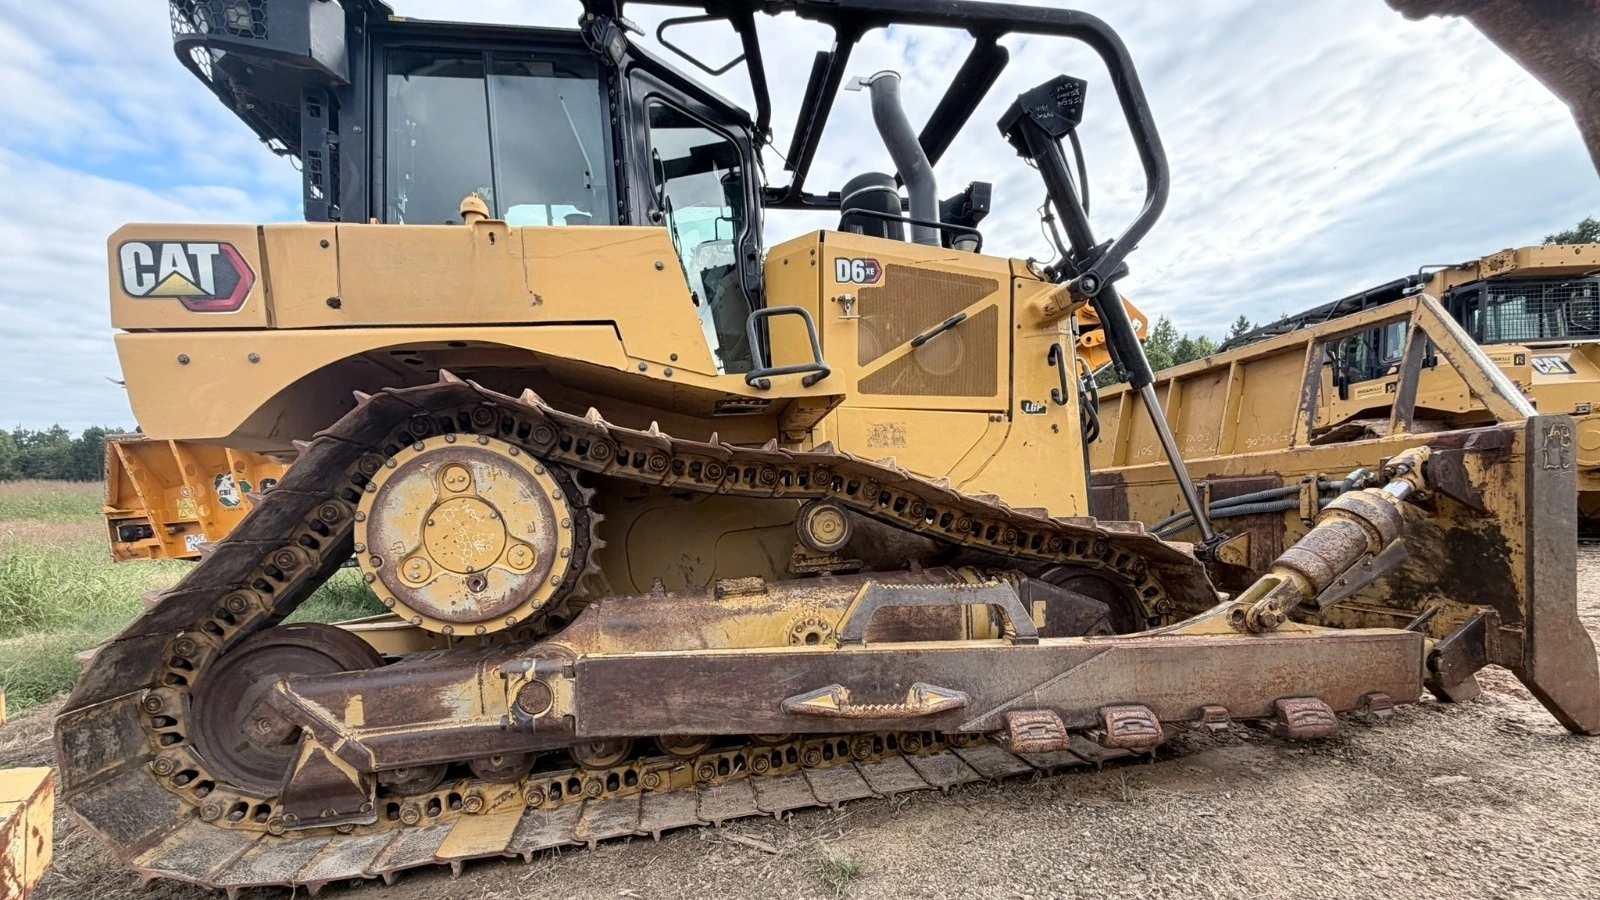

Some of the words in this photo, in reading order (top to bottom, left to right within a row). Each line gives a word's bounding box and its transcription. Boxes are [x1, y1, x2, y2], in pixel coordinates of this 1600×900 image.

[120, 242, 220, 296] CAT
[836, 259, 865, 283] D6
[865, 267, 875, 276] XE
[1531, 356, 1571, 374] CAT
